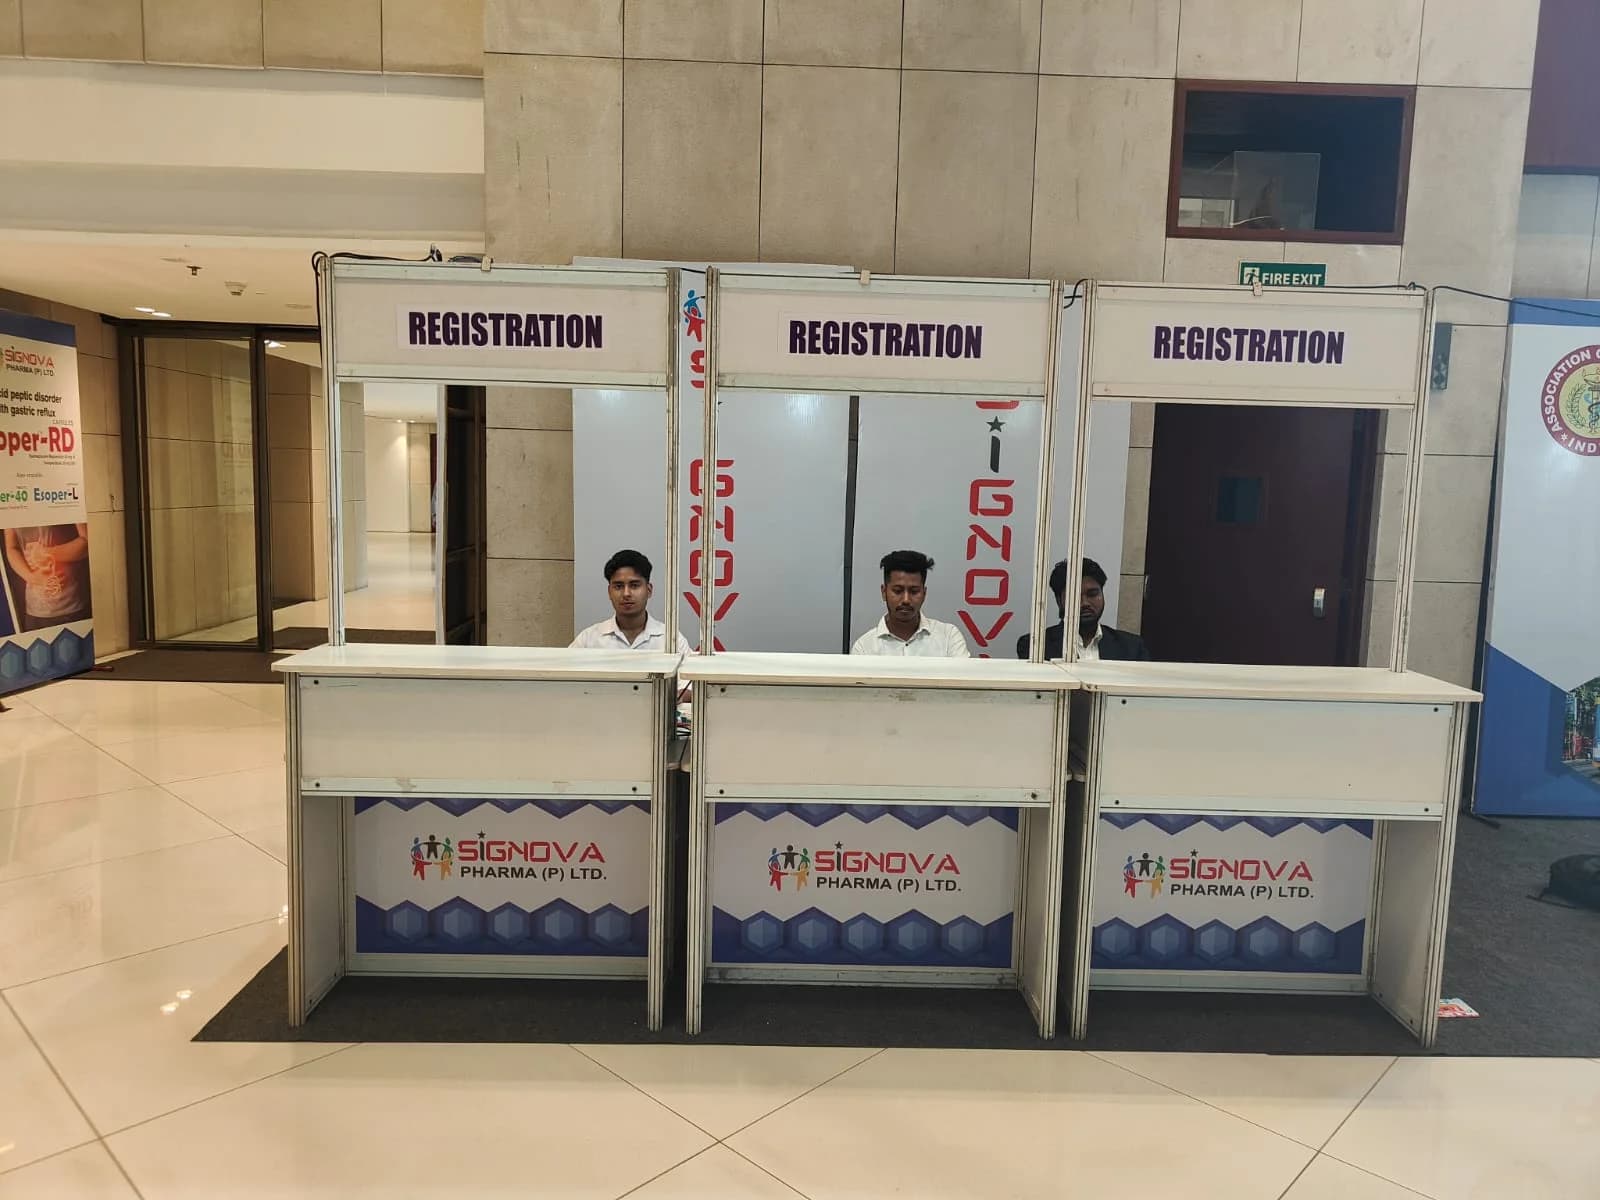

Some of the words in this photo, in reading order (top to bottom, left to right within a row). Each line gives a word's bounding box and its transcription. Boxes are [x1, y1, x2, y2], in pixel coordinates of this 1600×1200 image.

[1262, 272, 1292, 285] FIRE
[1293, 273, 1322, 286] EXIT
[409, 311, 602, 348] REGISTRATION
[789, 320, 983, 358] REGISTRATION
[1153, 325, 1345, 364] REGISTRATION
[6, 363, 33, 374] PHARMA
[10, 390, 33, 402] peptic
[34, 392, 62, 403] disorder
[1544, 349, 1591, 433] ASSOCIATION
[10, 405, 35, 417] gastric
[36, 407, 56, 417] reflux
[1568, 437, 1600, 453] IND
[34, 487, 79, 503] Esoper-L
[460, 866, 537, 879] PHARMA
[542, 867, 564, 882] (P)
[570, 868, 607, 880] LTD.
[816, 877, 892, 890] PHARMA
[897, 878, 920, 893] (P)
[925, 880, 962, 892] LTD.
[1170, 884, 1245, 897] PHARMA
[1250, 885, 1273, 900] (P)
[1278, 886, 1314, 899] LTD.
